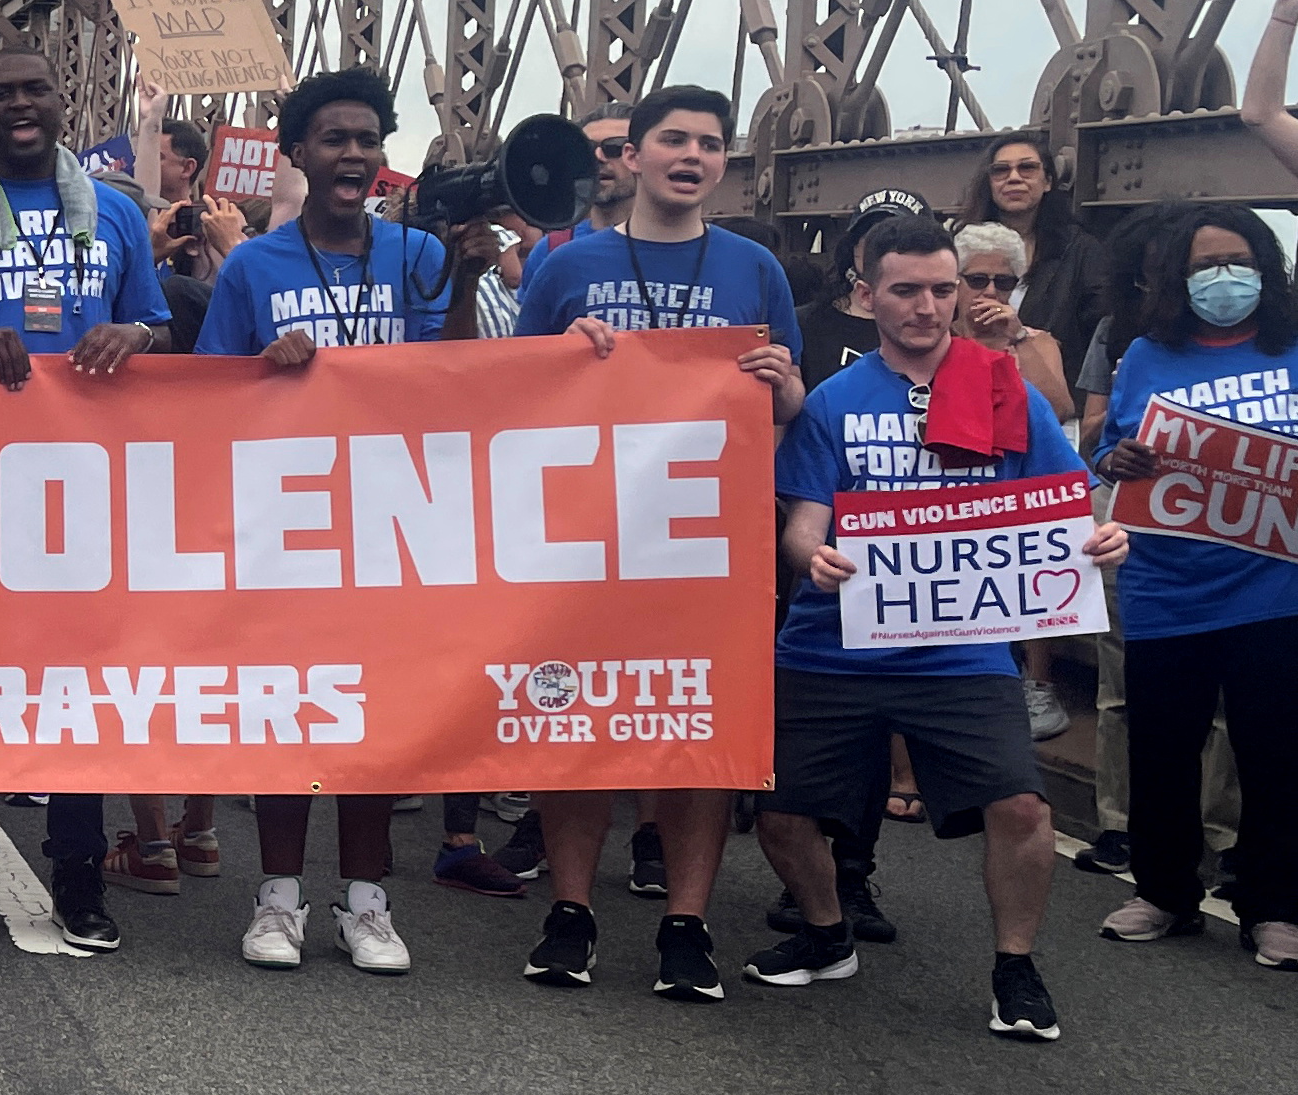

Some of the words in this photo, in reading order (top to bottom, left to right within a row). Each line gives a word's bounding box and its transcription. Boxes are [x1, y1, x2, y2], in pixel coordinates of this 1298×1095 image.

[152, 7, 226, 33] MAD
[211, 48, 258, 68] NOT
[150, 68, 213, 91] PAYING
[222, 136, 279, 167] NOT
[215, 167, 275, 197] ONE
[859, 190, 887, 214] NEW
[889, 190, 924, 215] YORK
[270, 284, 393, 323] MARCH
[586, 280, 713, 310] MARCH
[1160, 368, 1290, 408] MARCH
[844, 413, 921, 443] MAR
[1146, 410, 1216, 460] MY
[845, 445, 917, 477] FOR
[1160, 455, 1208, 477] WORTH
[1212, 469, 1253, 487] MORE
[1255, 480, 1293, 498] THAN
[840, 509, 896, 532] GUN
[902, 494, 1017, 526] VIOLENCE
[1024, 481, 1087, 509] KILLS
[867, 527, 1071, 577] NURSES
[875, 571, 1048, 625] HEAL
[870, 625, 1021, 640] #NursesAgainstGunViolence
[485, 658, 713, 711] YOUTH
[497, 714, 596, 743] OVER
[609, 712, 713, 742] GUNS
